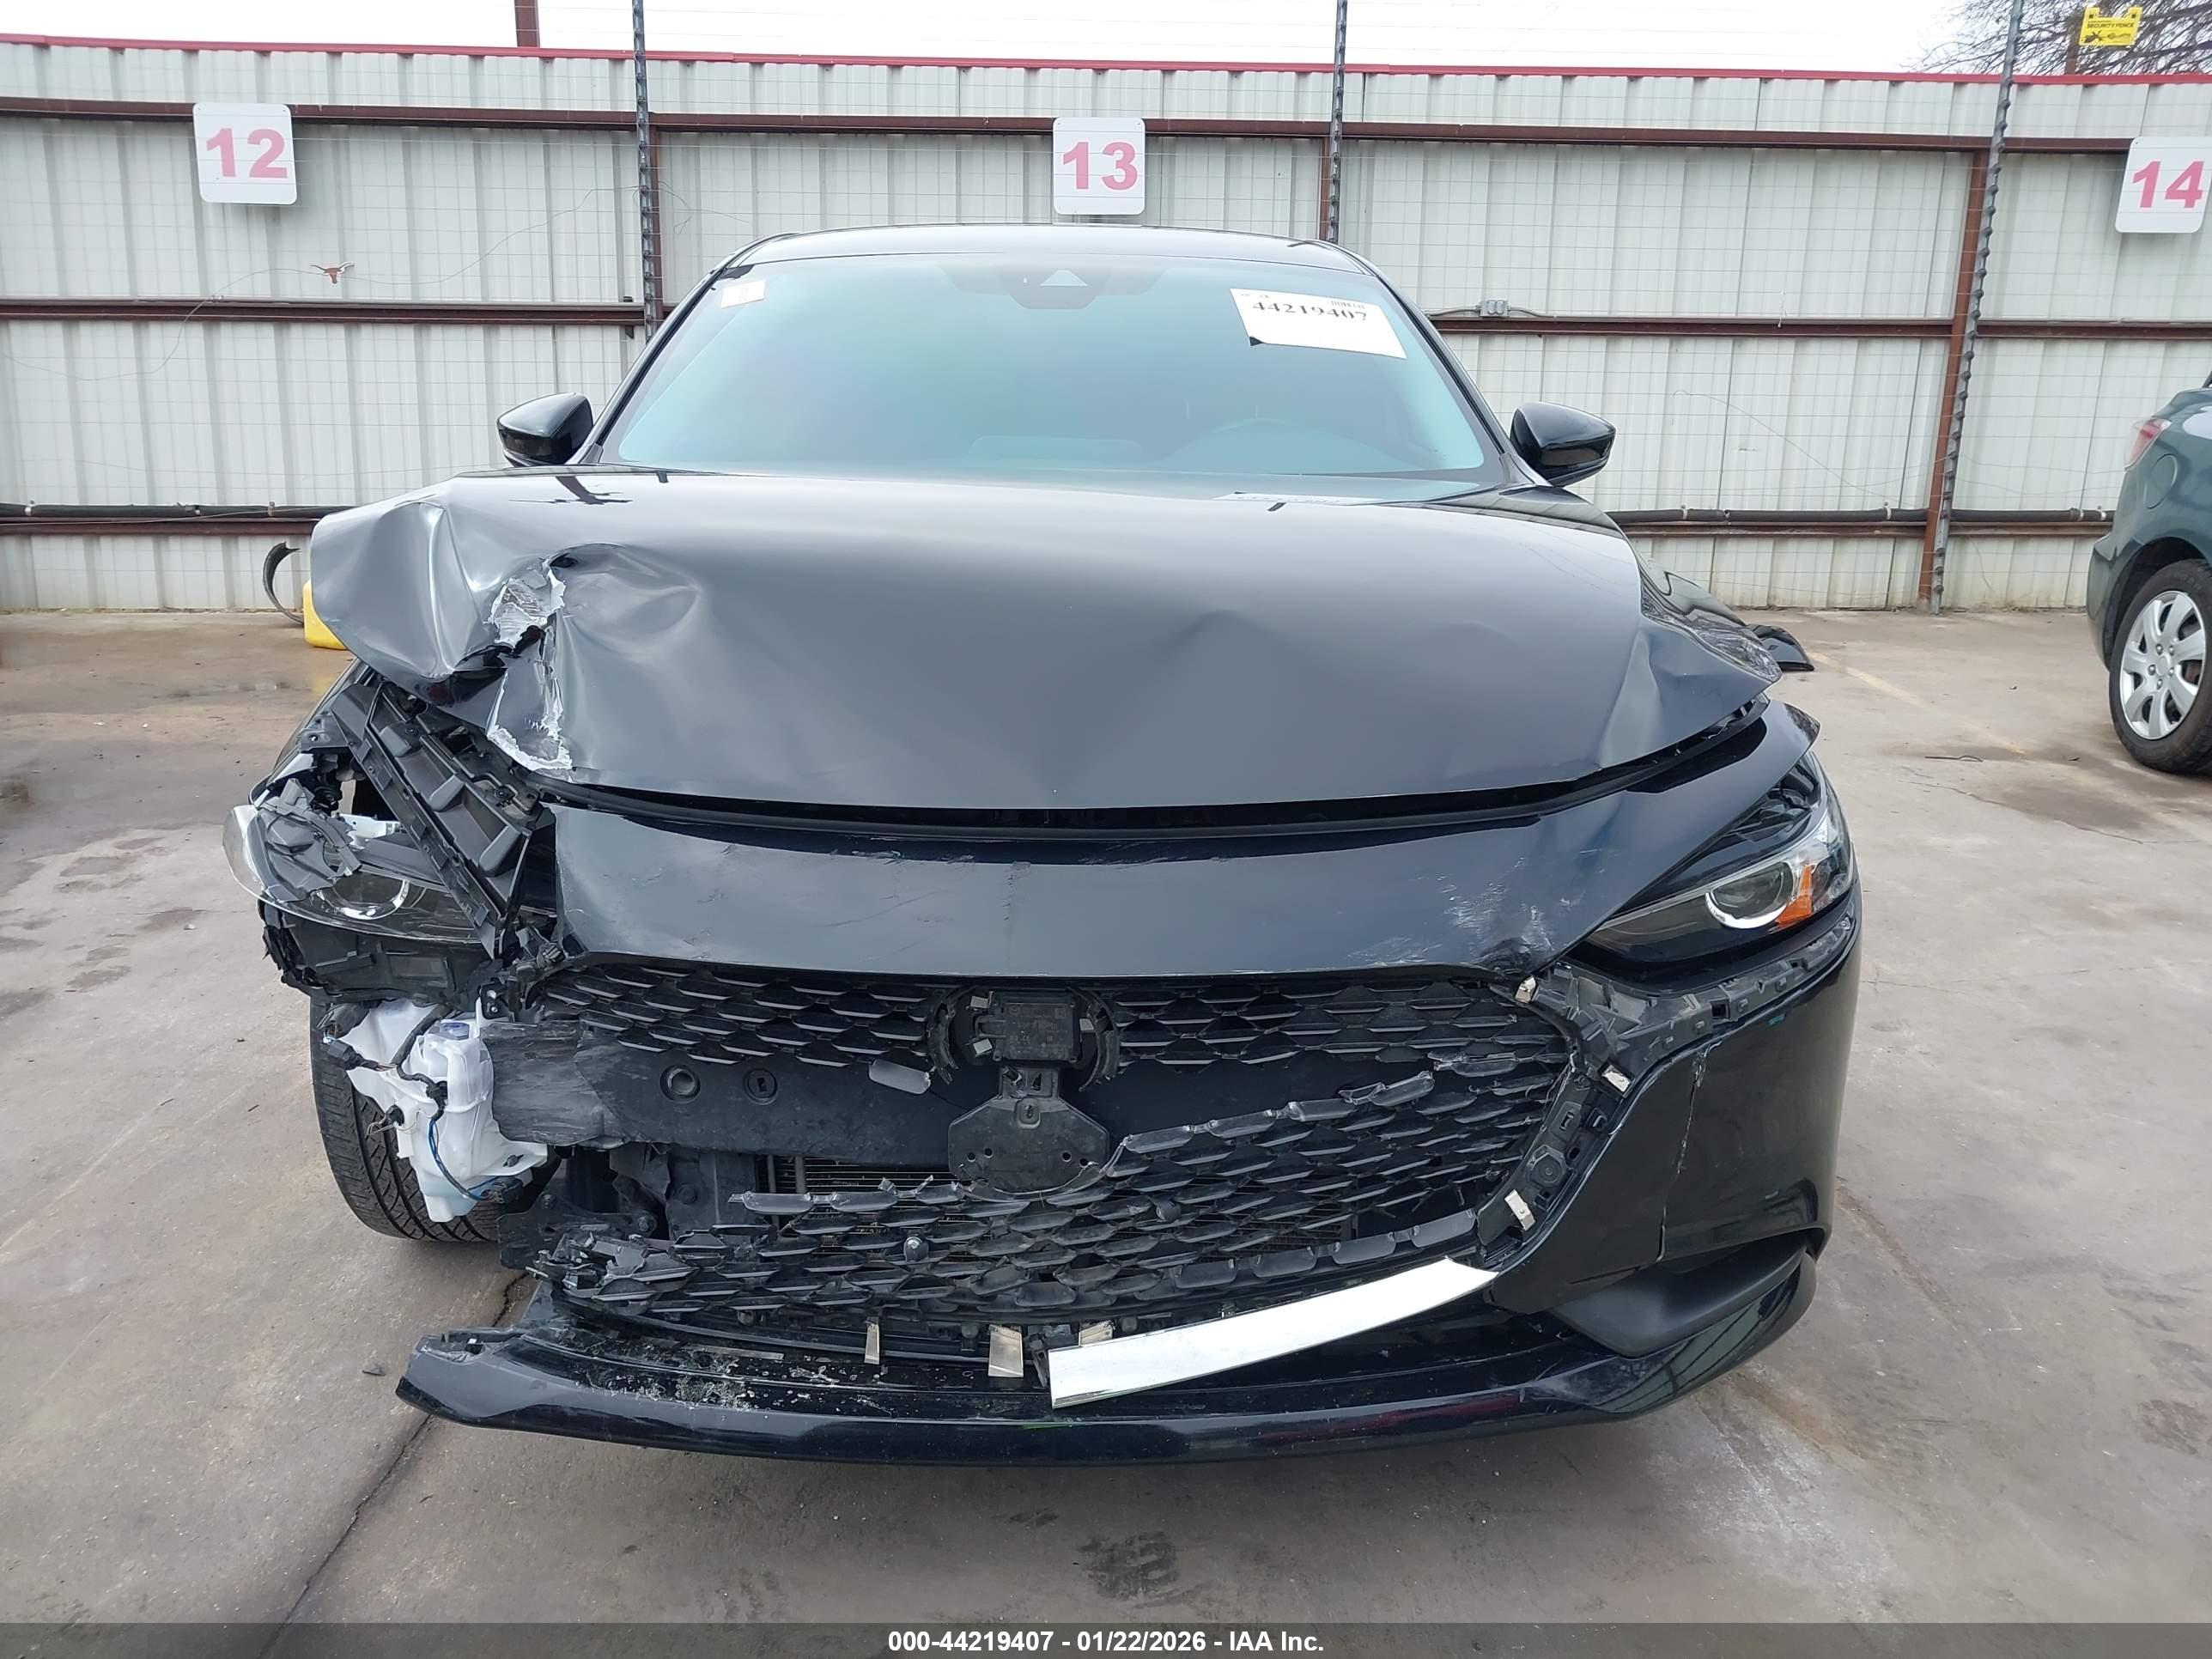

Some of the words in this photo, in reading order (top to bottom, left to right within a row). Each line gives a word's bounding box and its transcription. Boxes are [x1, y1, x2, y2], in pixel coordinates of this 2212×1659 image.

[205, 127, 289, 179] 12
[1062, 141, 1139, 191] 13
[2132, 160, 2205, 209] 14
[1252, 301, 1367, 321] 44219407
